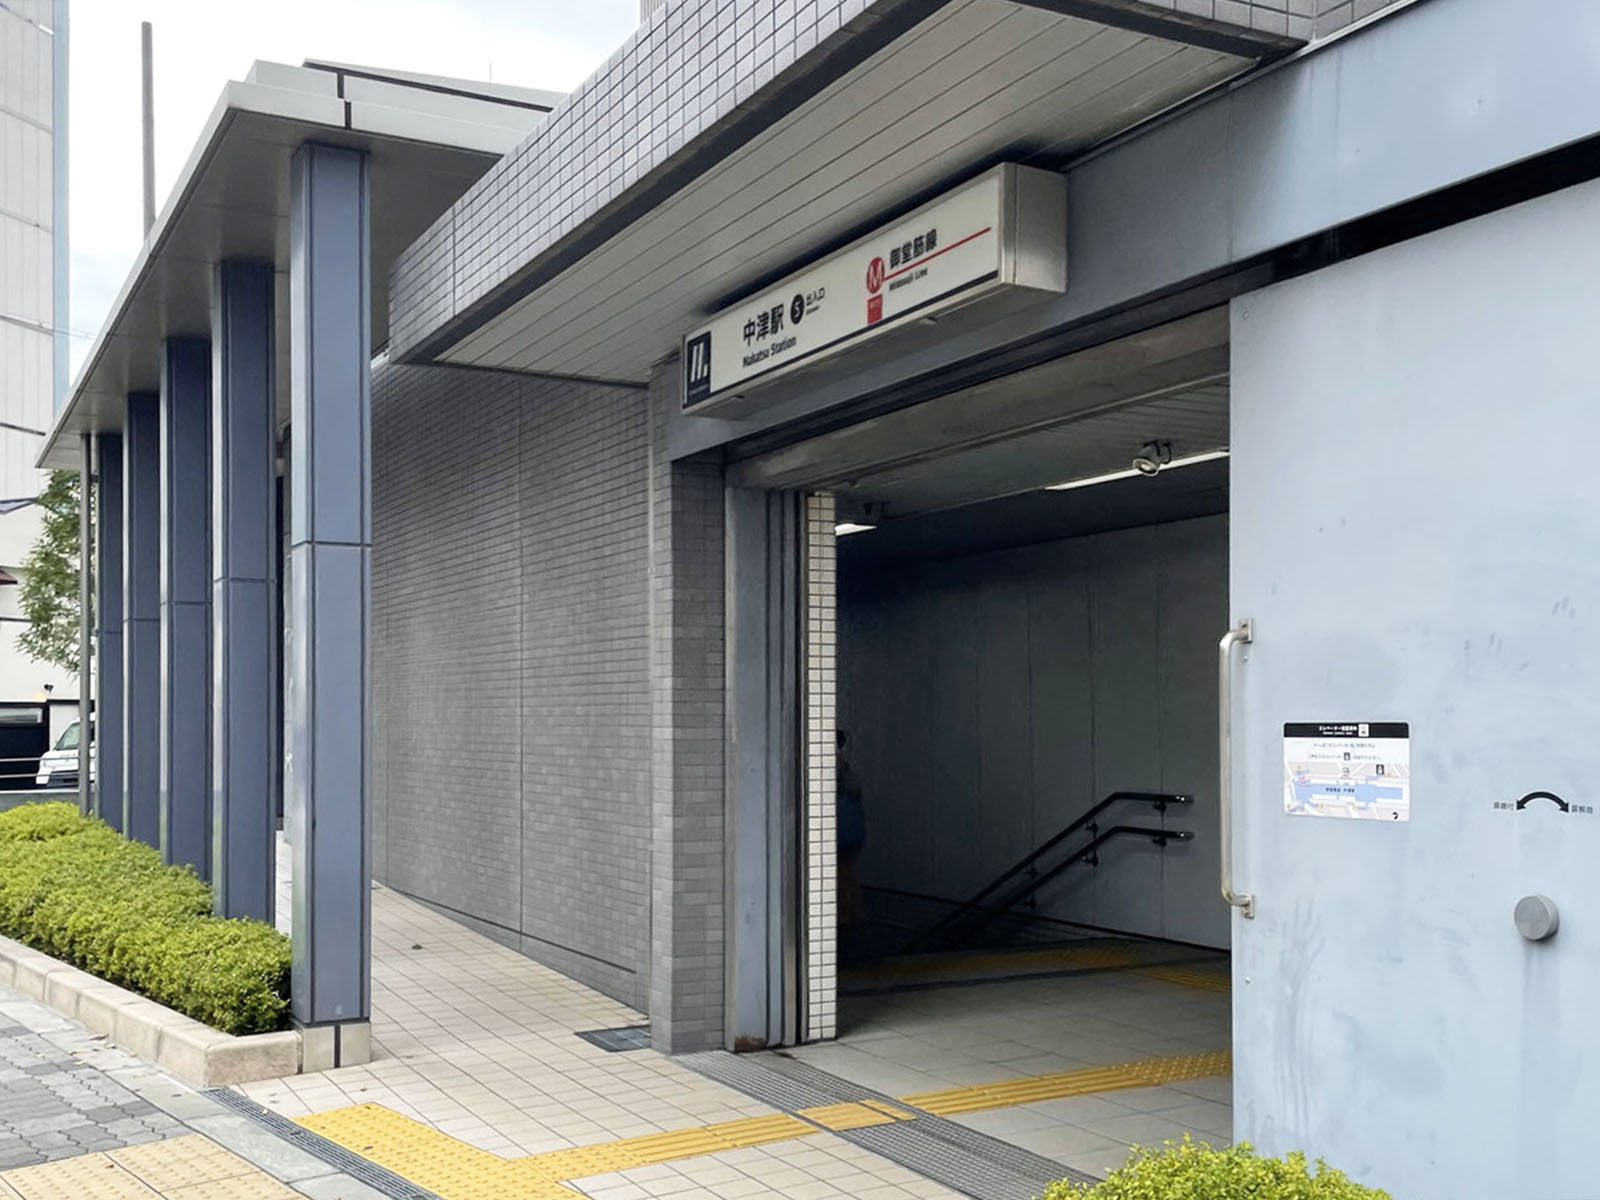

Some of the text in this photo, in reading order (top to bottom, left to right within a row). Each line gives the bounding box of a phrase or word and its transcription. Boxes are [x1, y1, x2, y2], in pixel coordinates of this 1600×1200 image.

[743, 303, 784, 346] 中津駅
[743, 336, 797, 367] Nakatsu Station
